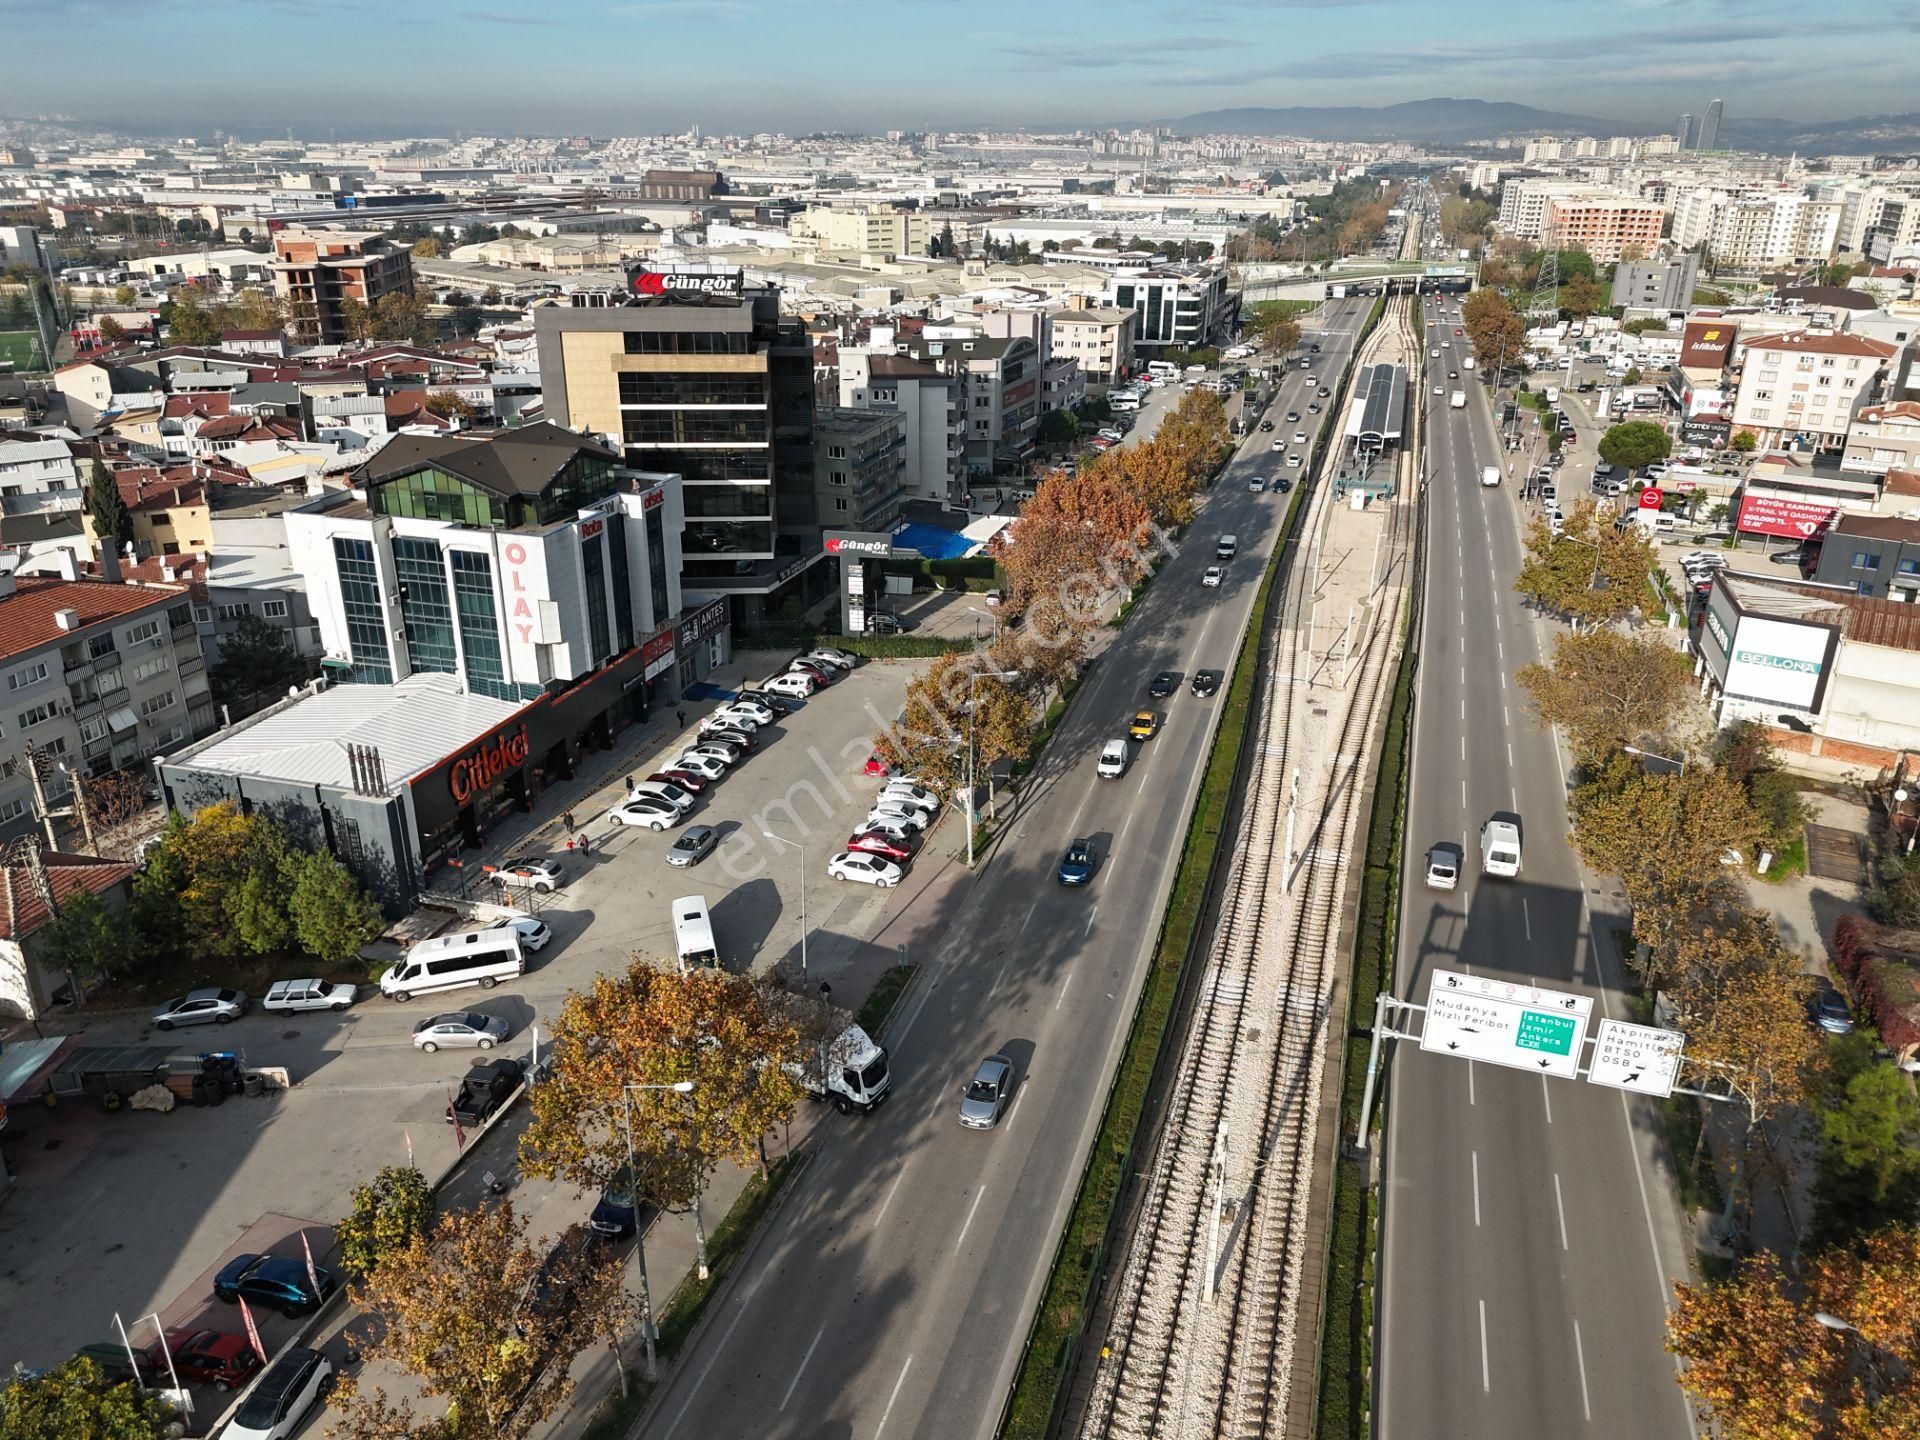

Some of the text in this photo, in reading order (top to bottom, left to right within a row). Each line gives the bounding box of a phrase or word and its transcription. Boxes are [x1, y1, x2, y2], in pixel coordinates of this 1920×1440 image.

[661, 274, 737, 292] Güngör
[1691, 341, 1726, 352] istikbal
[1685, 421, 1710, 430] bambi
[1747, 506, 1776, 515] X-TRAIL
[1756, 499, 1832, 514] BÜYÜK KAMPANYA
[839, 539, 889, 552] Güngör
[505, 543, 533, 645] OLAY
[701, 601, 724, 627] ANTES
[1741, 651, 1816, 673] BELLONA
[1435, 998, 1498, 1018] Mudanya
[1464, 1014, 1509, 1030] Feribot
[1519, 1031, 1561, 1046] Ankara
[1604, 1045, 1640, 1058] BTSO
[1602, 1055, 1630, 1067] OSB
